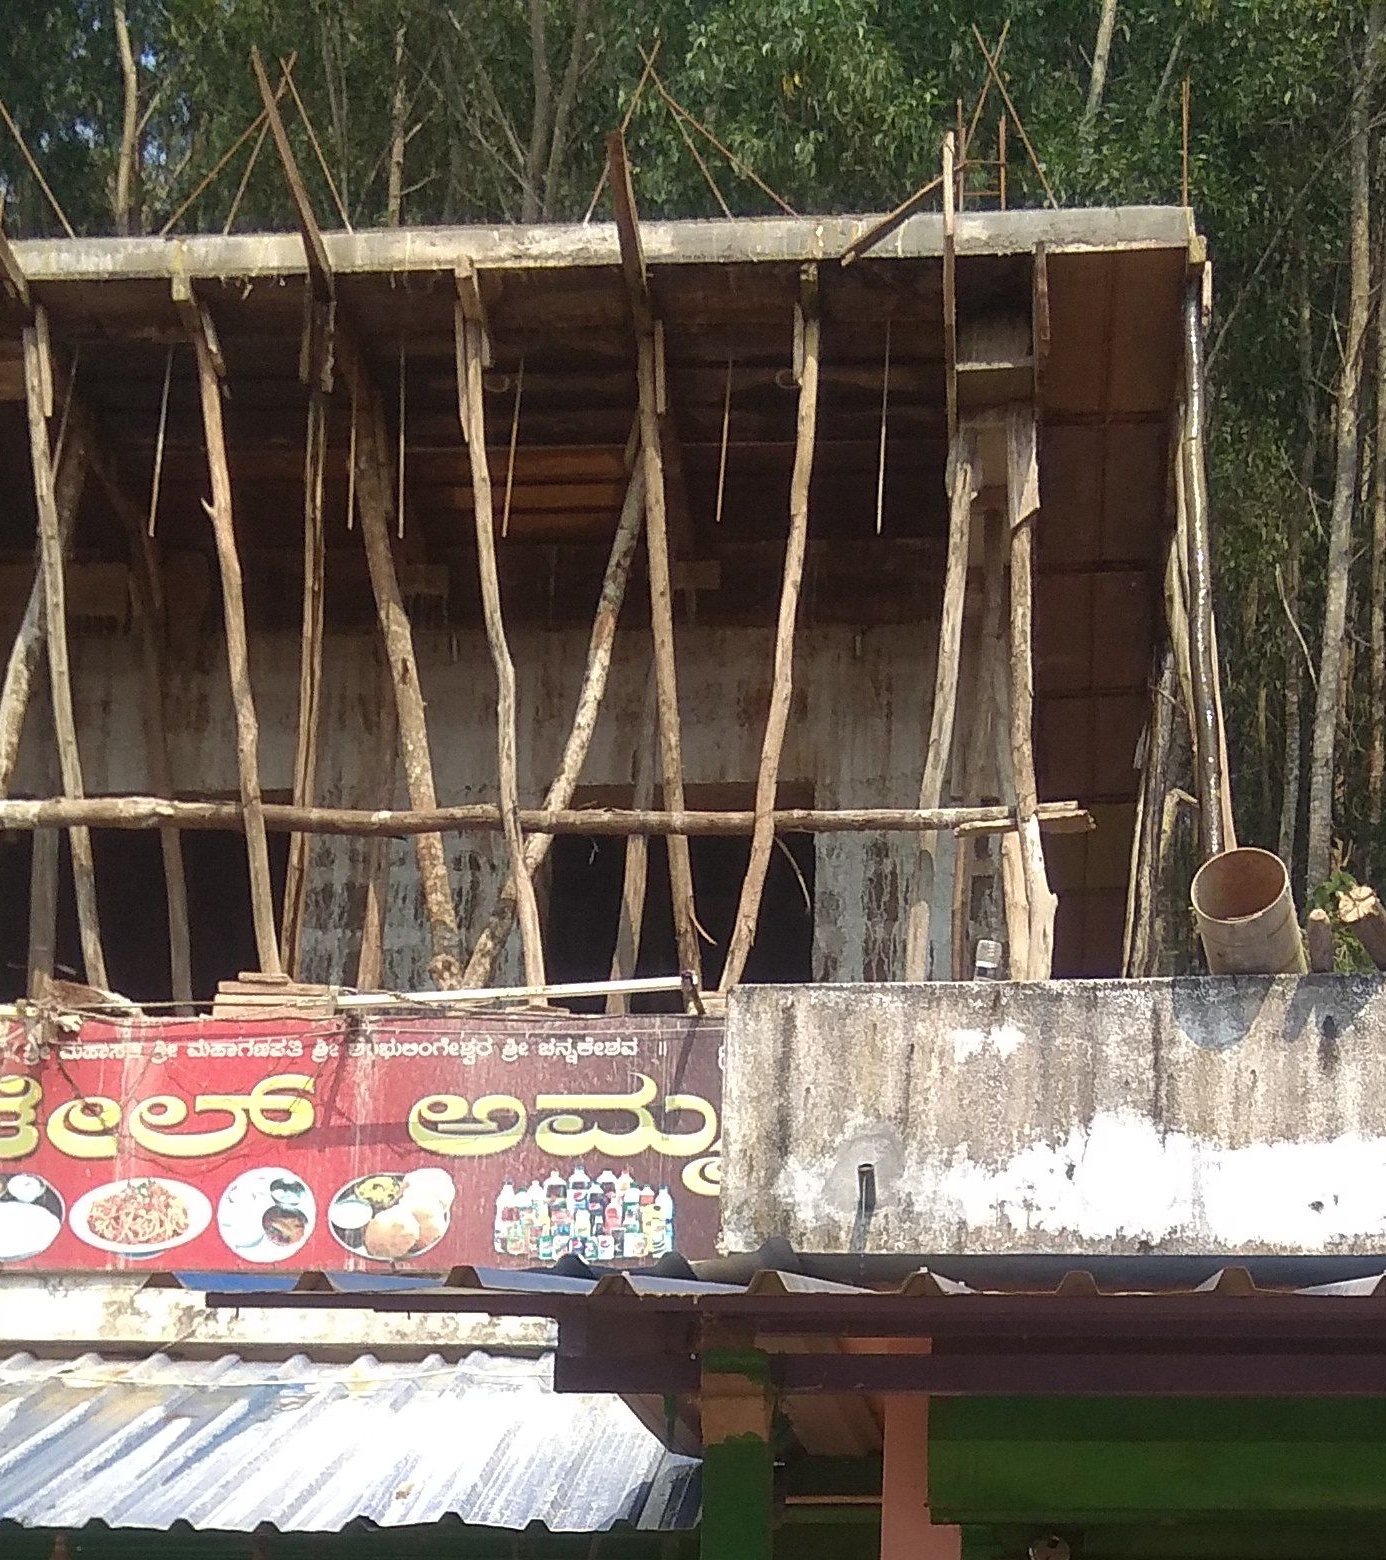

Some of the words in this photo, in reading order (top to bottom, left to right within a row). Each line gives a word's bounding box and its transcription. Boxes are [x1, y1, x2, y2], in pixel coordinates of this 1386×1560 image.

[150, 1039, 180, 1065] ಶ್ರೀ
[186, 1038, 305, 1059] ಮಹಾಗಣಪತಿ
[311, 1037, 340, 1064] ಶ್ರೀ
[501, 1037, 529, 1062] ಶ್ರೀ
